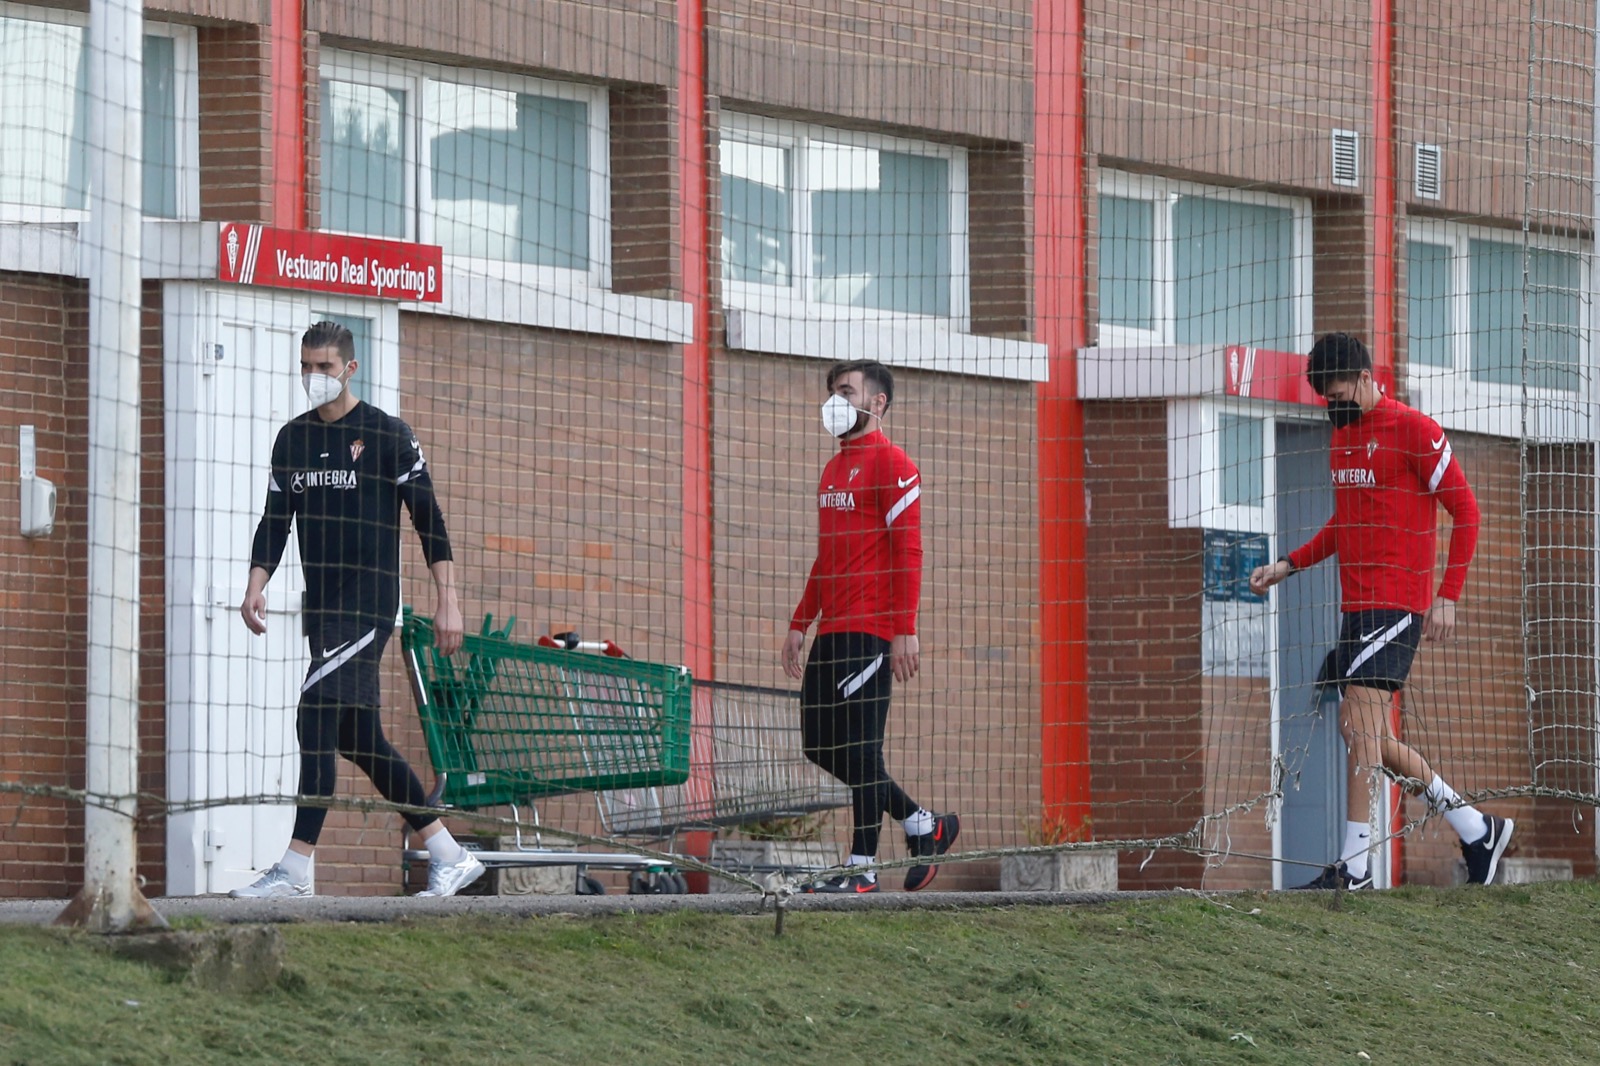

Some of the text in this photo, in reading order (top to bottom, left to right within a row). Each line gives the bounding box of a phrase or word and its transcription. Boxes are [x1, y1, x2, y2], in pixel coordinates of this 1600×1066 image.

[276, 249, 436, 300] Vestuario Real Sporting B
[306, 470, 358, 487] INTEGRA
[1338, 468, 1376, 484] INTEGRA
[820, 492, 855, 508] INTEGRA
